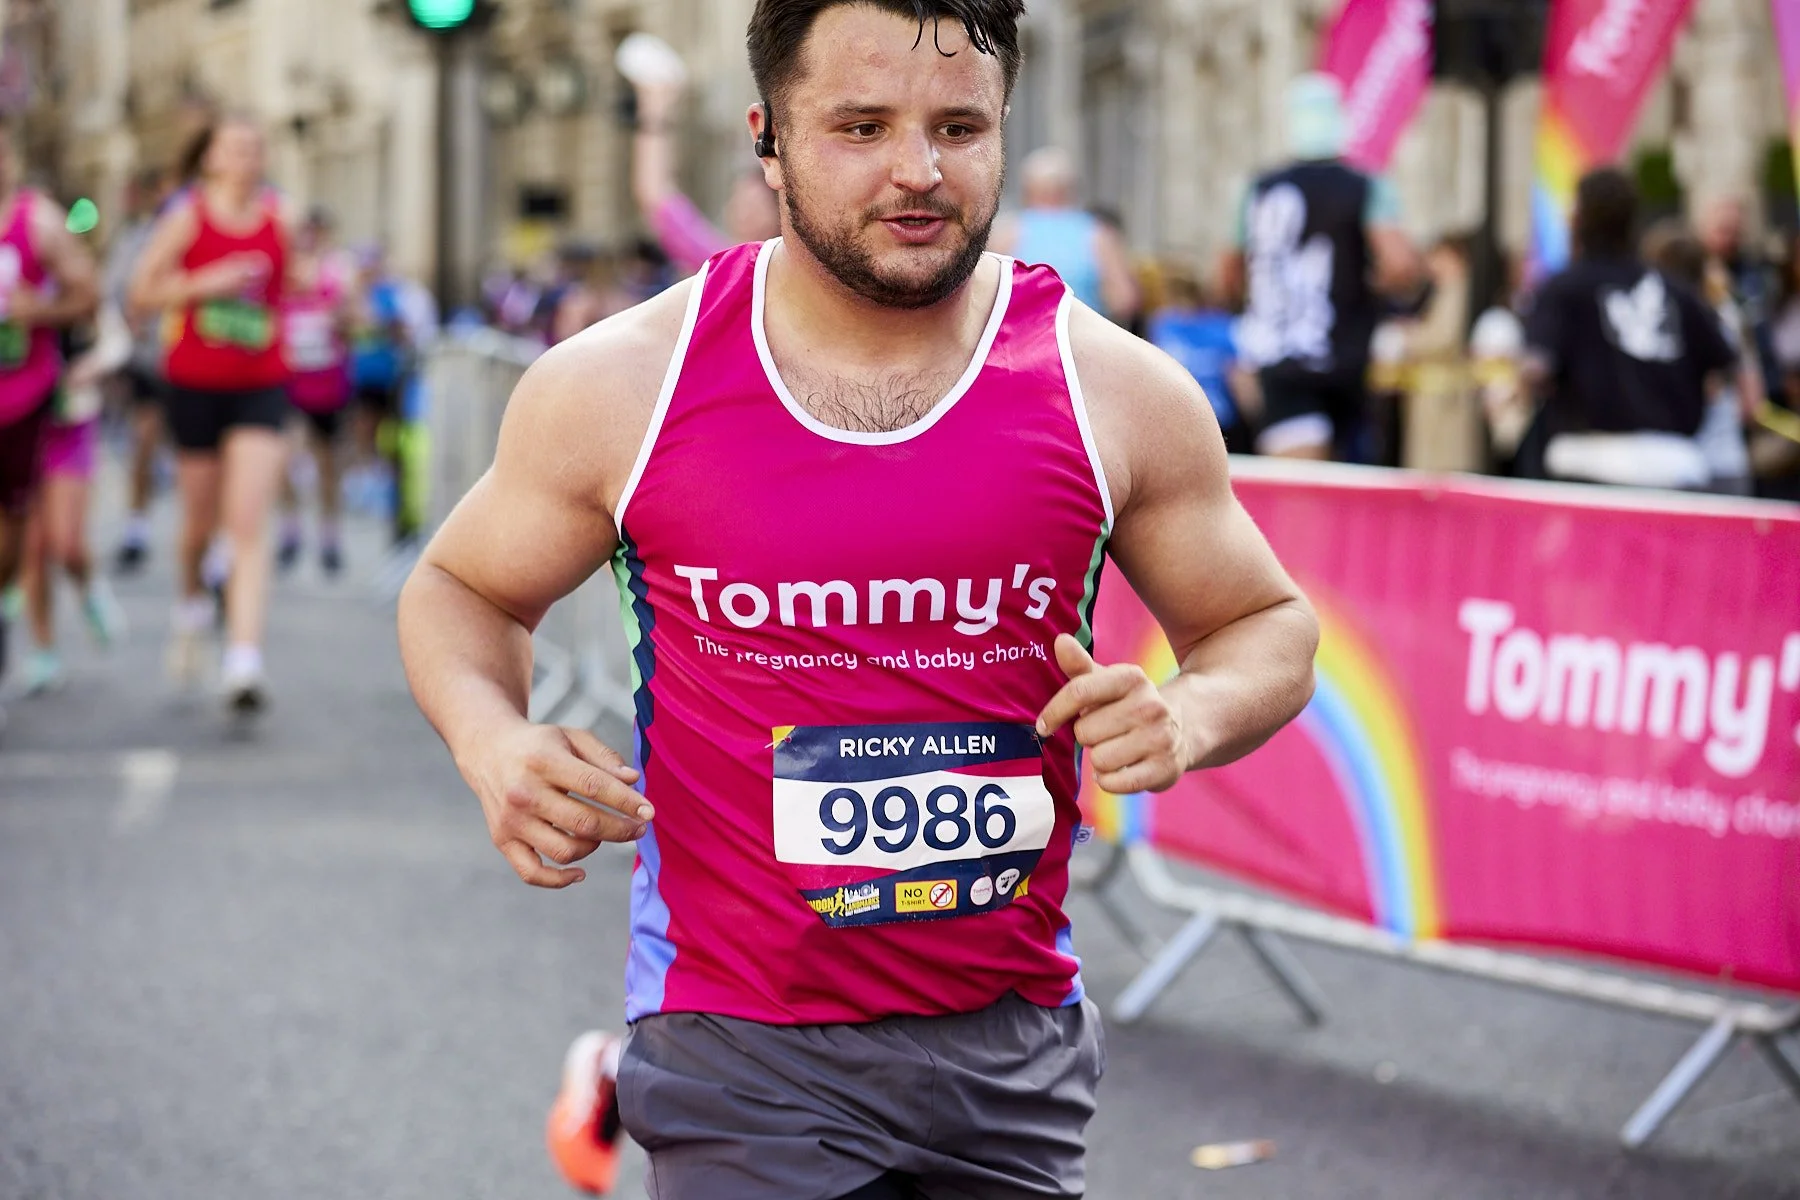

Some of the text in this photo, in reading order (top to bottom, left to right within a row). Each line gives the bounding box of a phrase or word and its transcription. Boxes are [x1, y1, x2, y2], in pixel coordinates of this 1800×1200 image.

[673, 563, 1057, 637] Tommy's
[693, 634, 729, 657] The
[866, 650, 911, 669] and
[915, 647, 974, 670] baby
[1457, 597, 1800, 779] Tommy'
[839, 735, 996, 758] RICKY ALLEN
[818, 783, 1016, 856] 9986
[903, 888, 923, 898] NO
